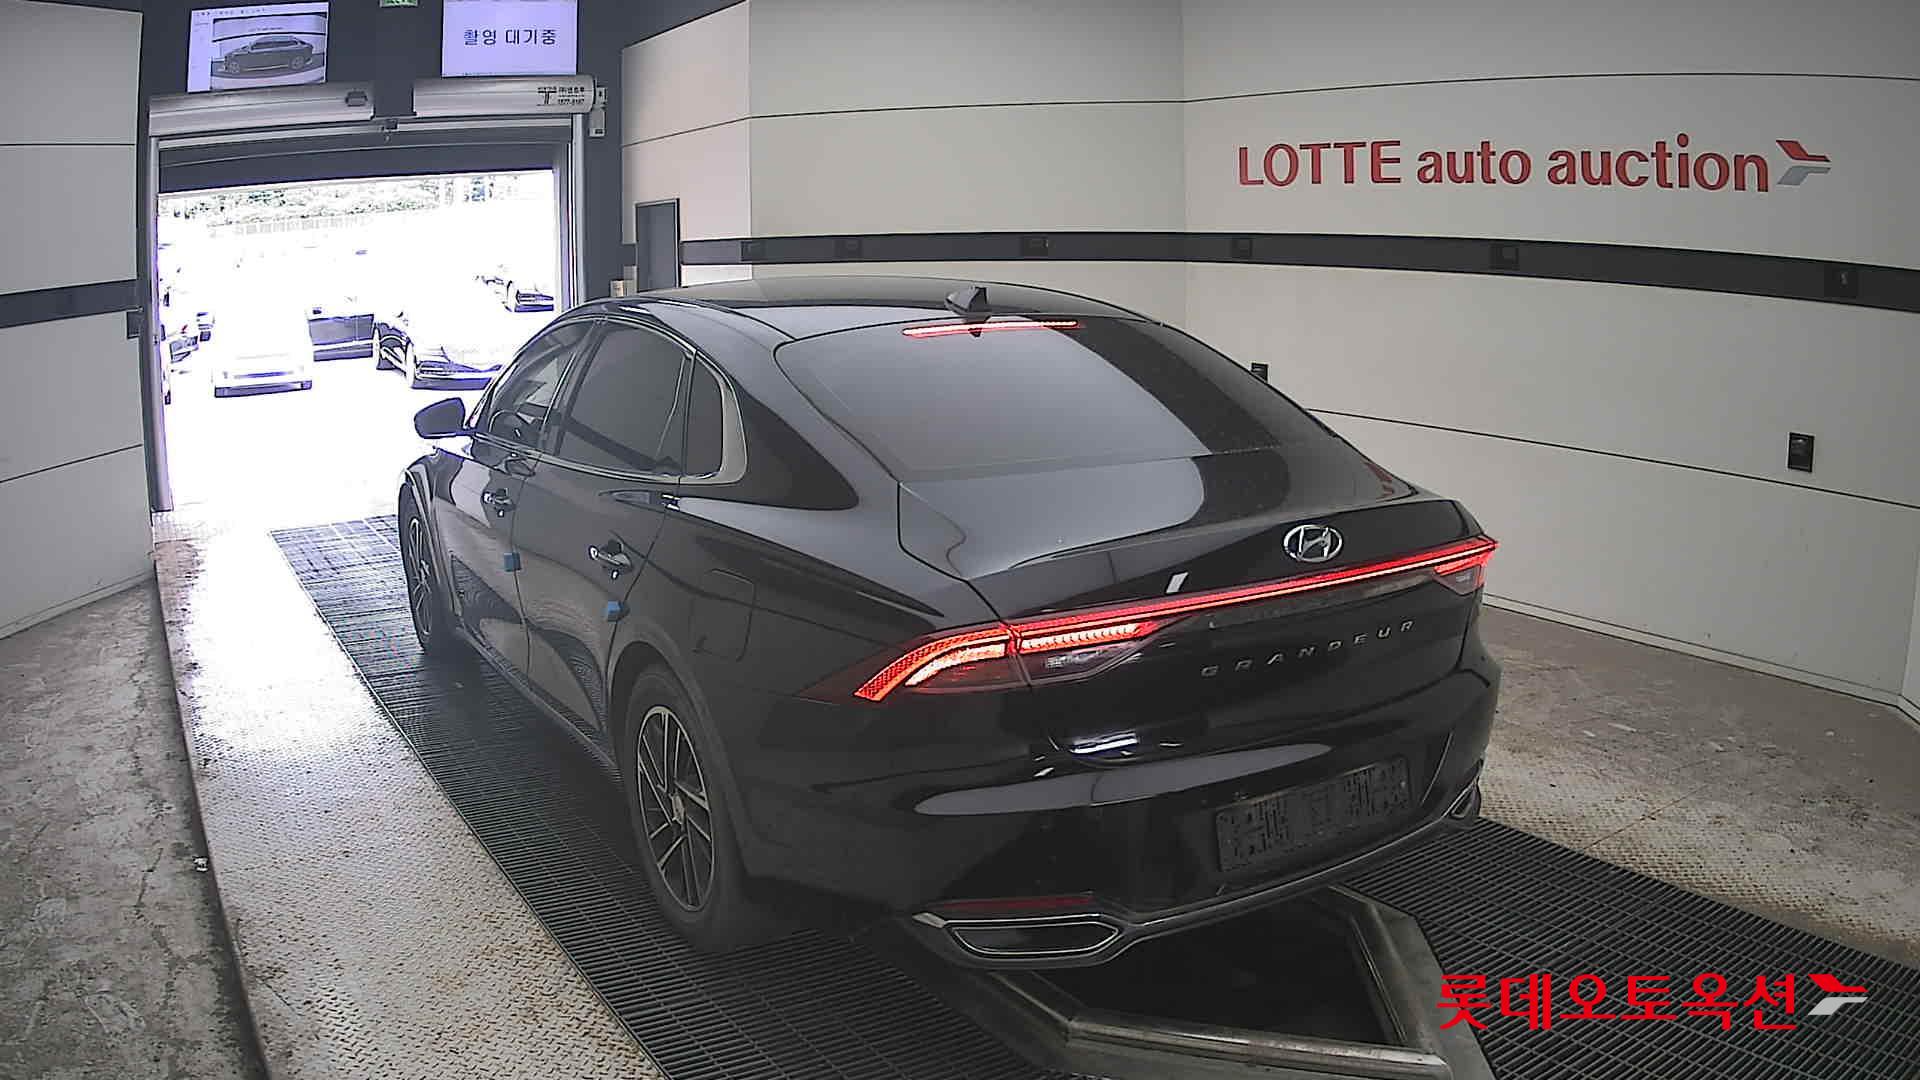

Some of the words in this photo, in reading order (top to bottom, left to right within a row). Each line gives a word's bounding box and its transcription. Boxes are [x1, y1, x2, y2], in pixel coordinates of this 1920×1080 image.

[505, 28, 557, 46] 대기중
[1238, 140, 1400, 187] LOTTE
[1417, 140, 1532, 185] auto
[1547, 133, 1769, 192] auction
[1201, 620, 1413, 677] GRANDEUR
